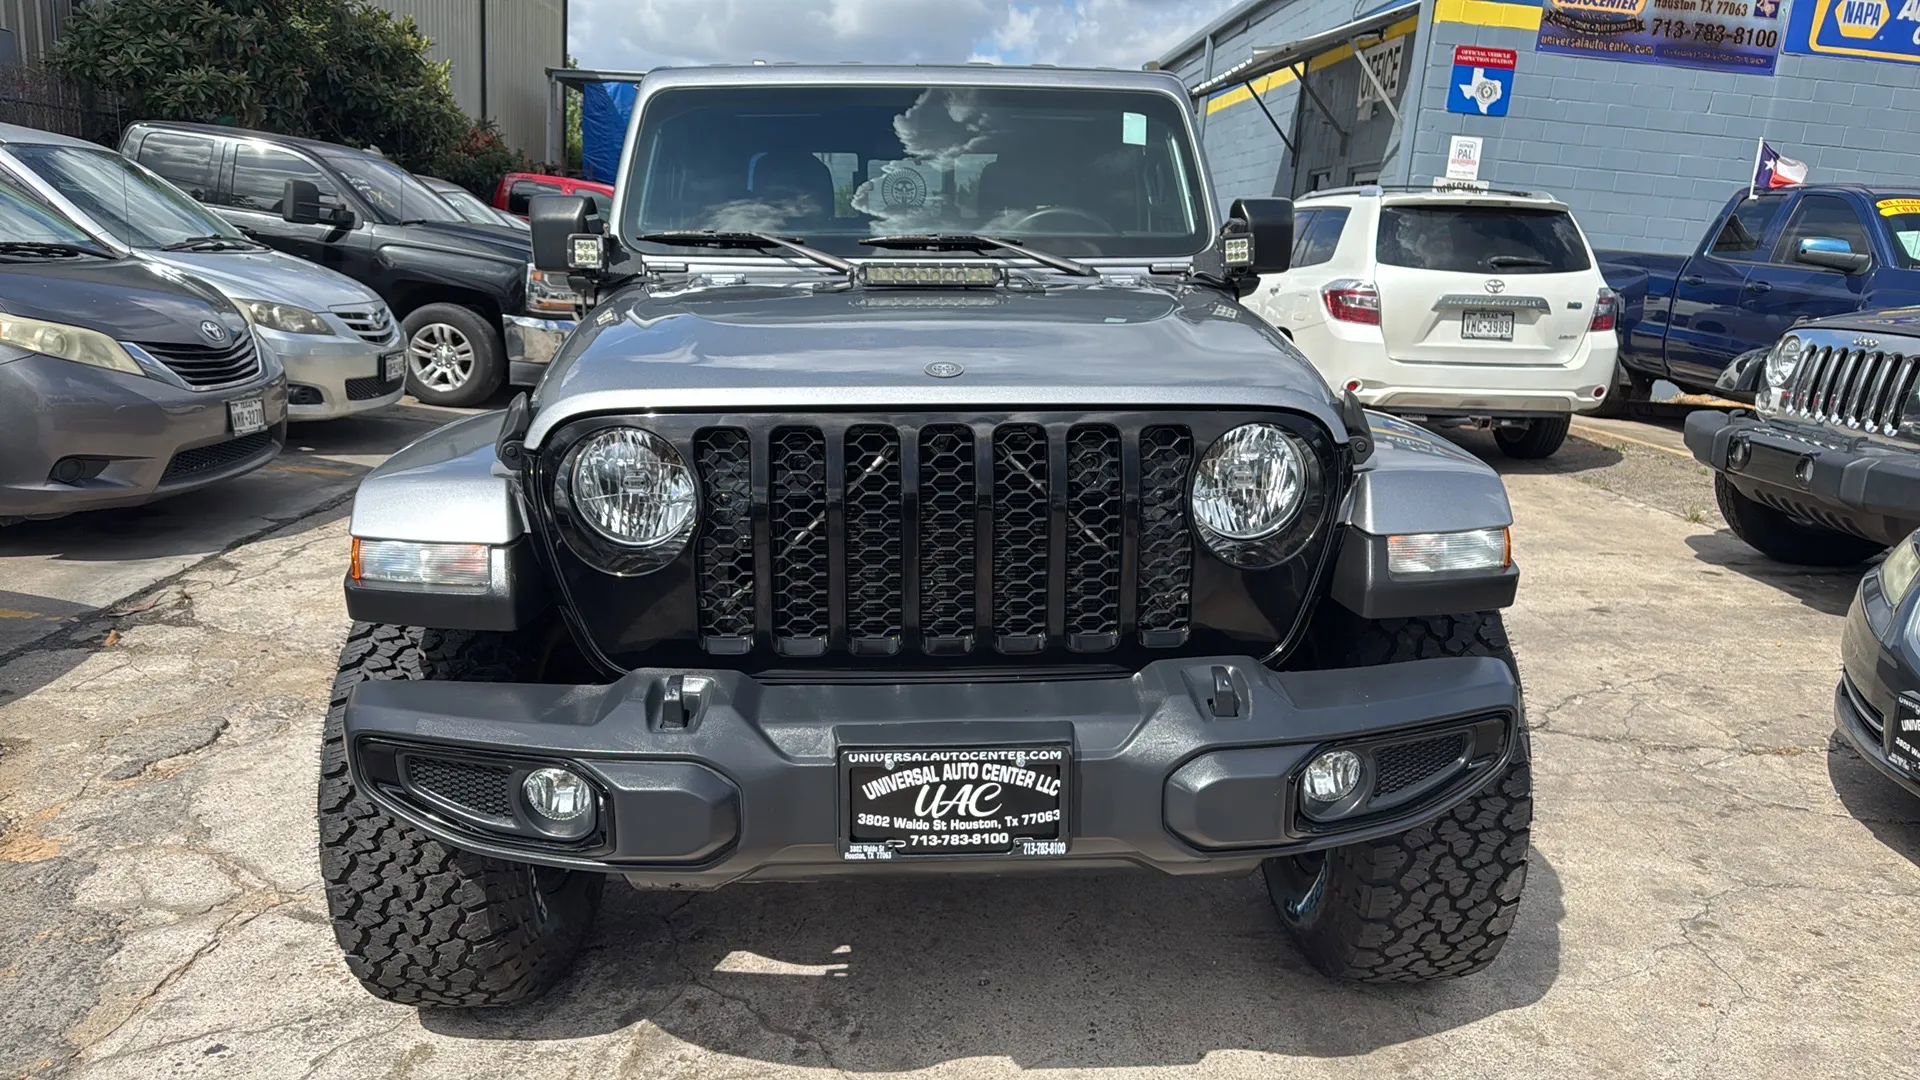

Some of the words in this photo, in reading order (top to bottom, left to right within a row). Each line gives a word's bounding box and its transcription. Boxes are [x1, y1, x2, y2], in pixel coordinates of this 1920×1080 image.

[1700, 0, 1713, 13] TX
[1716, 2, 1748, 17] 77063
[1843, 1, 1881, 26] NAPA
[1652, 19, 1778, 48] 713-783-8100
[1456, 55, 1490, 63] INSPECTION
[1461, 49, 1487, 57] OFFICIAL
[1487, 51, 1511, 59] VEHICLE
[1458, 148, 1472, 159] PAL
[1479, 311, 1499, 319] TEXAS
[848, 751, 1062, 763] UNIVERSALAUTOCENTER.COM
[862, 765, 940, 800] UNIVERSAL
[942, 762, 979, 781] AUTO
[981, 763, 1036, 789] CENTER
[1035, 774, 1061, 797] LLC
[914, 782, 1003, 818] UAC
[857, 813, 890, 828] 3802
[893, 816, 930, 830] Waldo
[932, 819, 947, 831] St
[950, 819, 1002, 830] Houston,
[1004, 815, 1019, 827] Tx
[1021, 809, 1060, 826] 77063
[910, 832, 1009, 846] 713-783-8100
[1023, 842, 1066, 855] 713-783-8100
